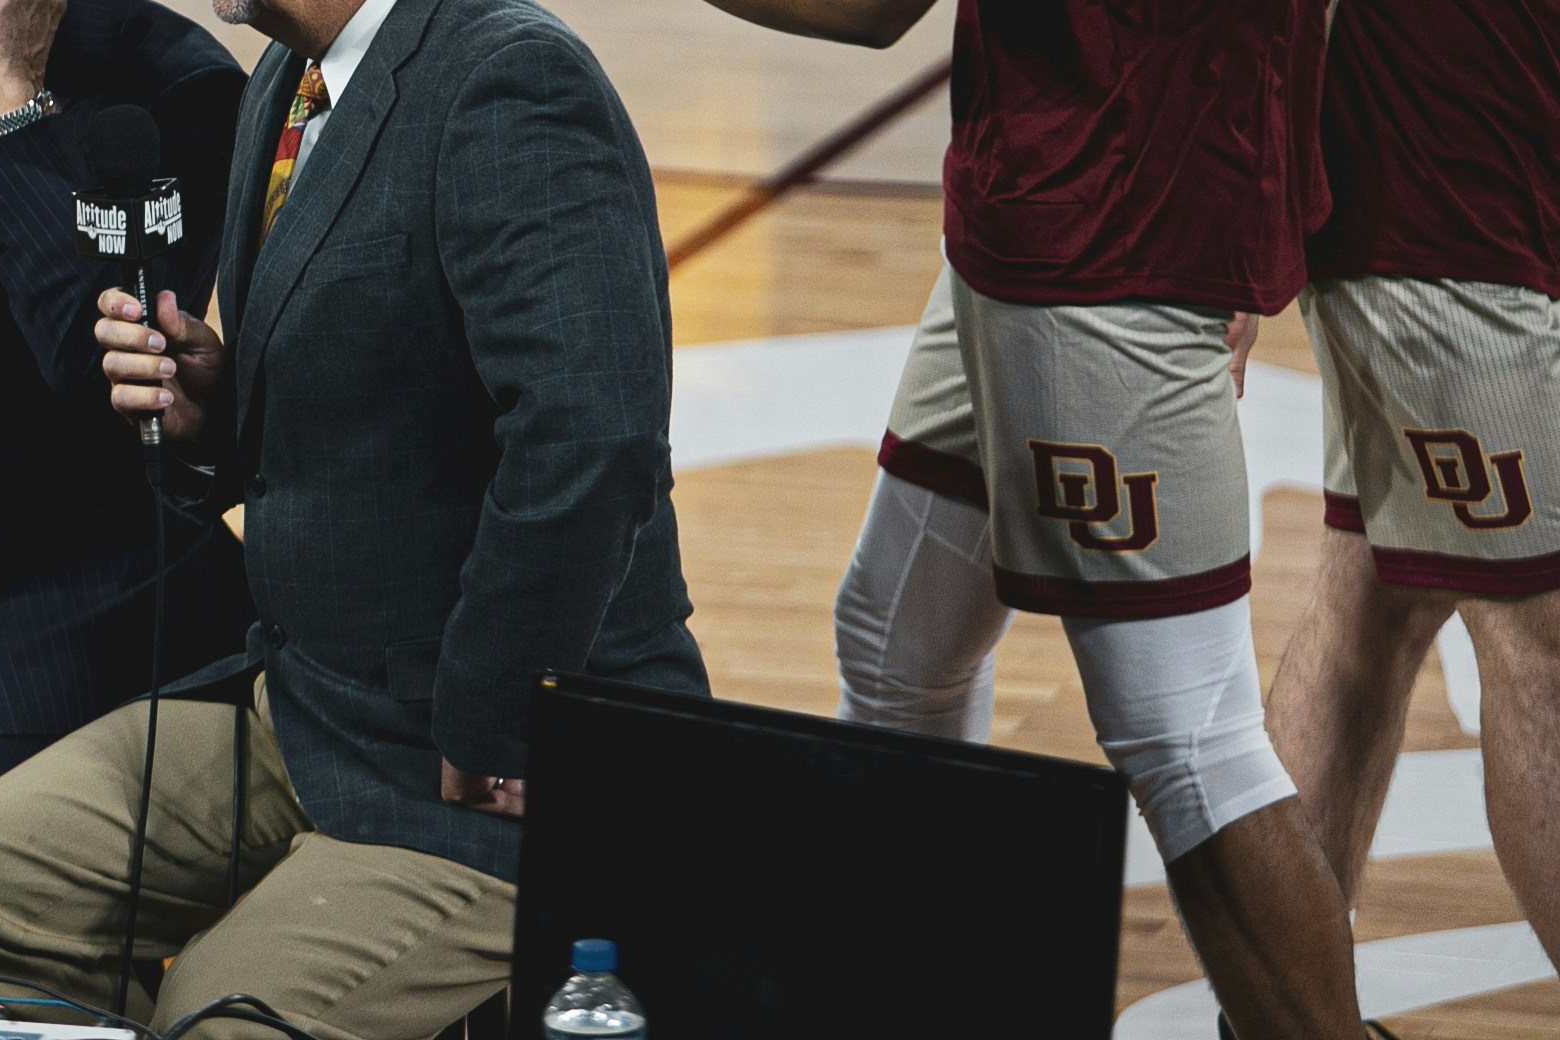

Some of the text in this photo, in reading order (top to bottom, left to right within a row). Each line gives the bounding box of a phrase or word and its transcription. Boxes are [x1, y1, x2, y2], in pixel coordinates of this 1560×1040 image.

[76, 199, 127, 230] Altitude
[144, 189, 182, 228] Altitude
[98, 234, 126, 255] NOW
[1026, 438, 1159, 554] DU
[1402, 427, 1533, 531] DU
